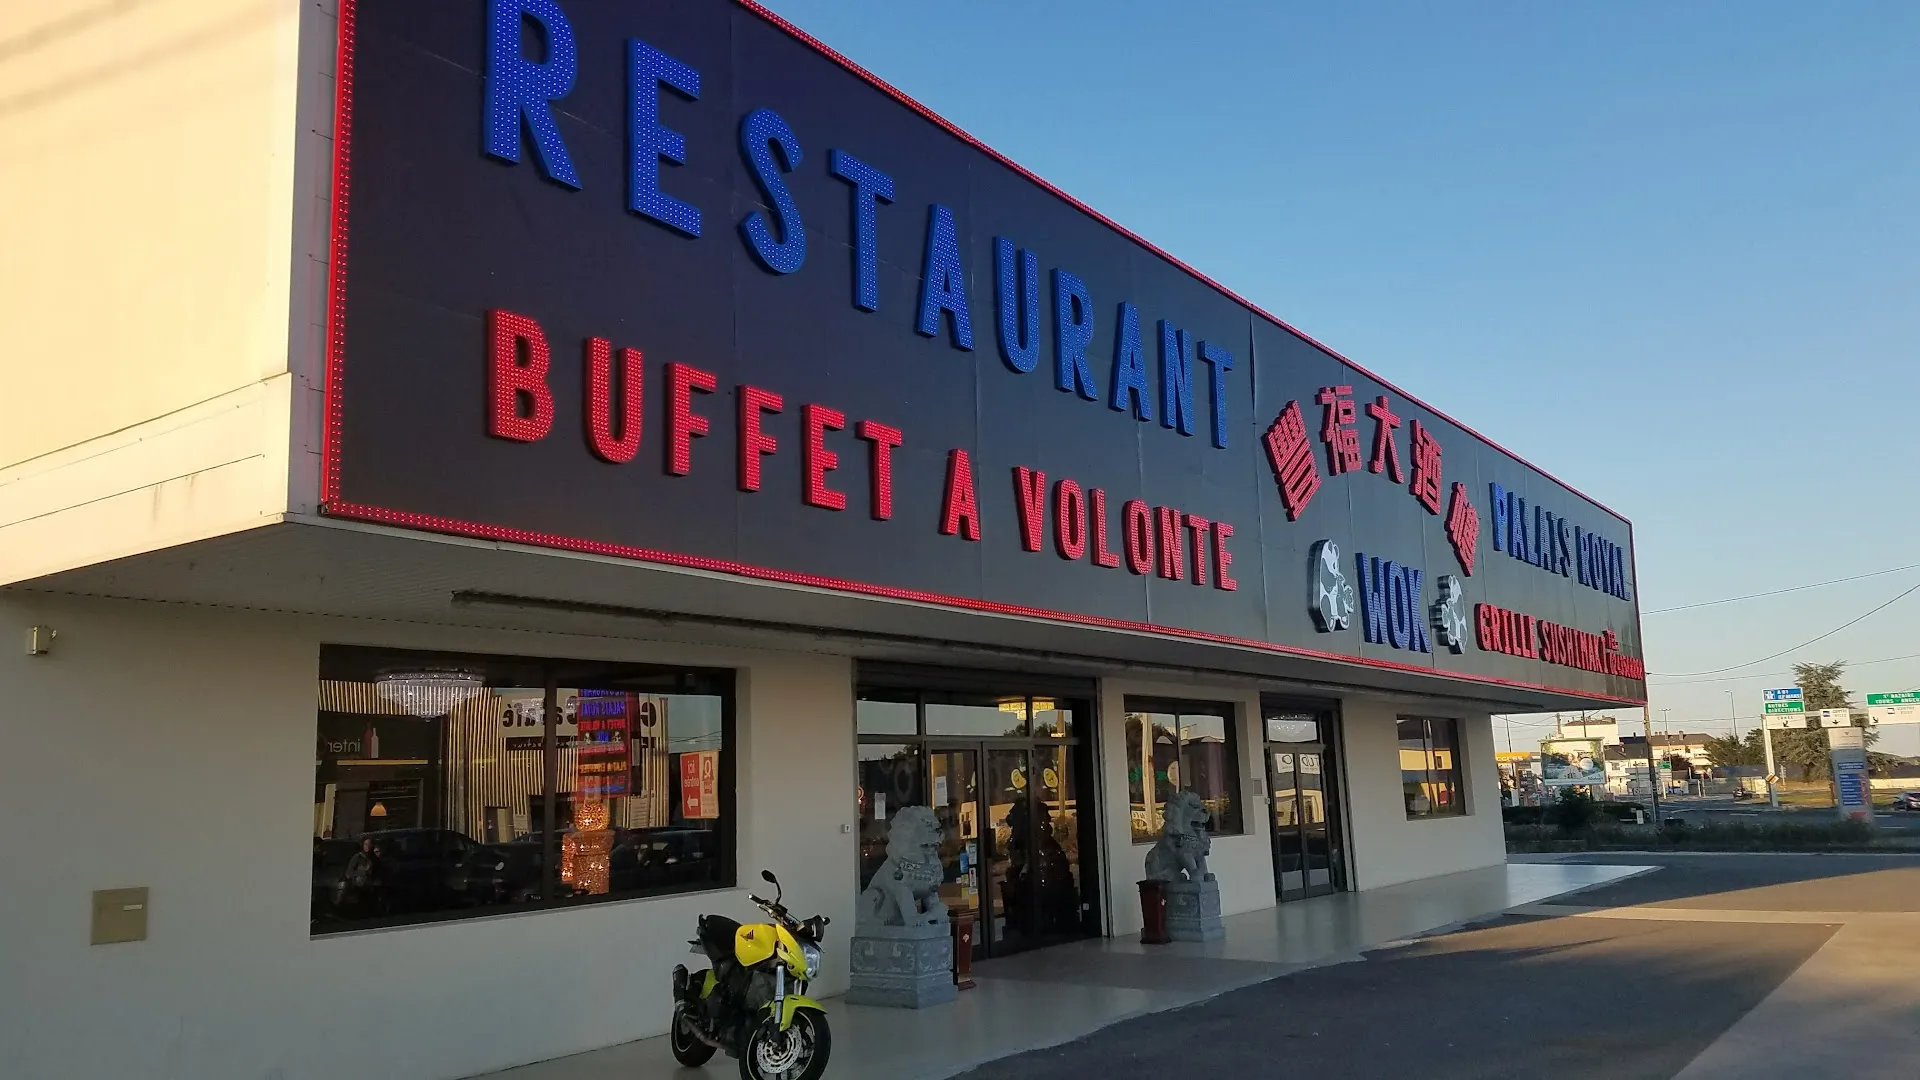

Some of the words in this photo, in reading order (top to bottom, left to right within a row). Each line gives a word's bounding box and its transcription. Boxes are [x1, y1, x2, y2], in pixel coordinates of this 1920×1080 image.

[484, 0, 1233, 449] RESTAURANT
[487, 308, 904, 520] BUFFET
[938, 448, 980, 541] A
[1012, 466, 1237, 591] VOLONTE
[1489, 482, 1574, 578] PALAIS
[1575, 525, 1631, 601] ROYAL
[1355, 552, 1432, 653] WOK
[1474, 602, 1539, 659] GRILLE
